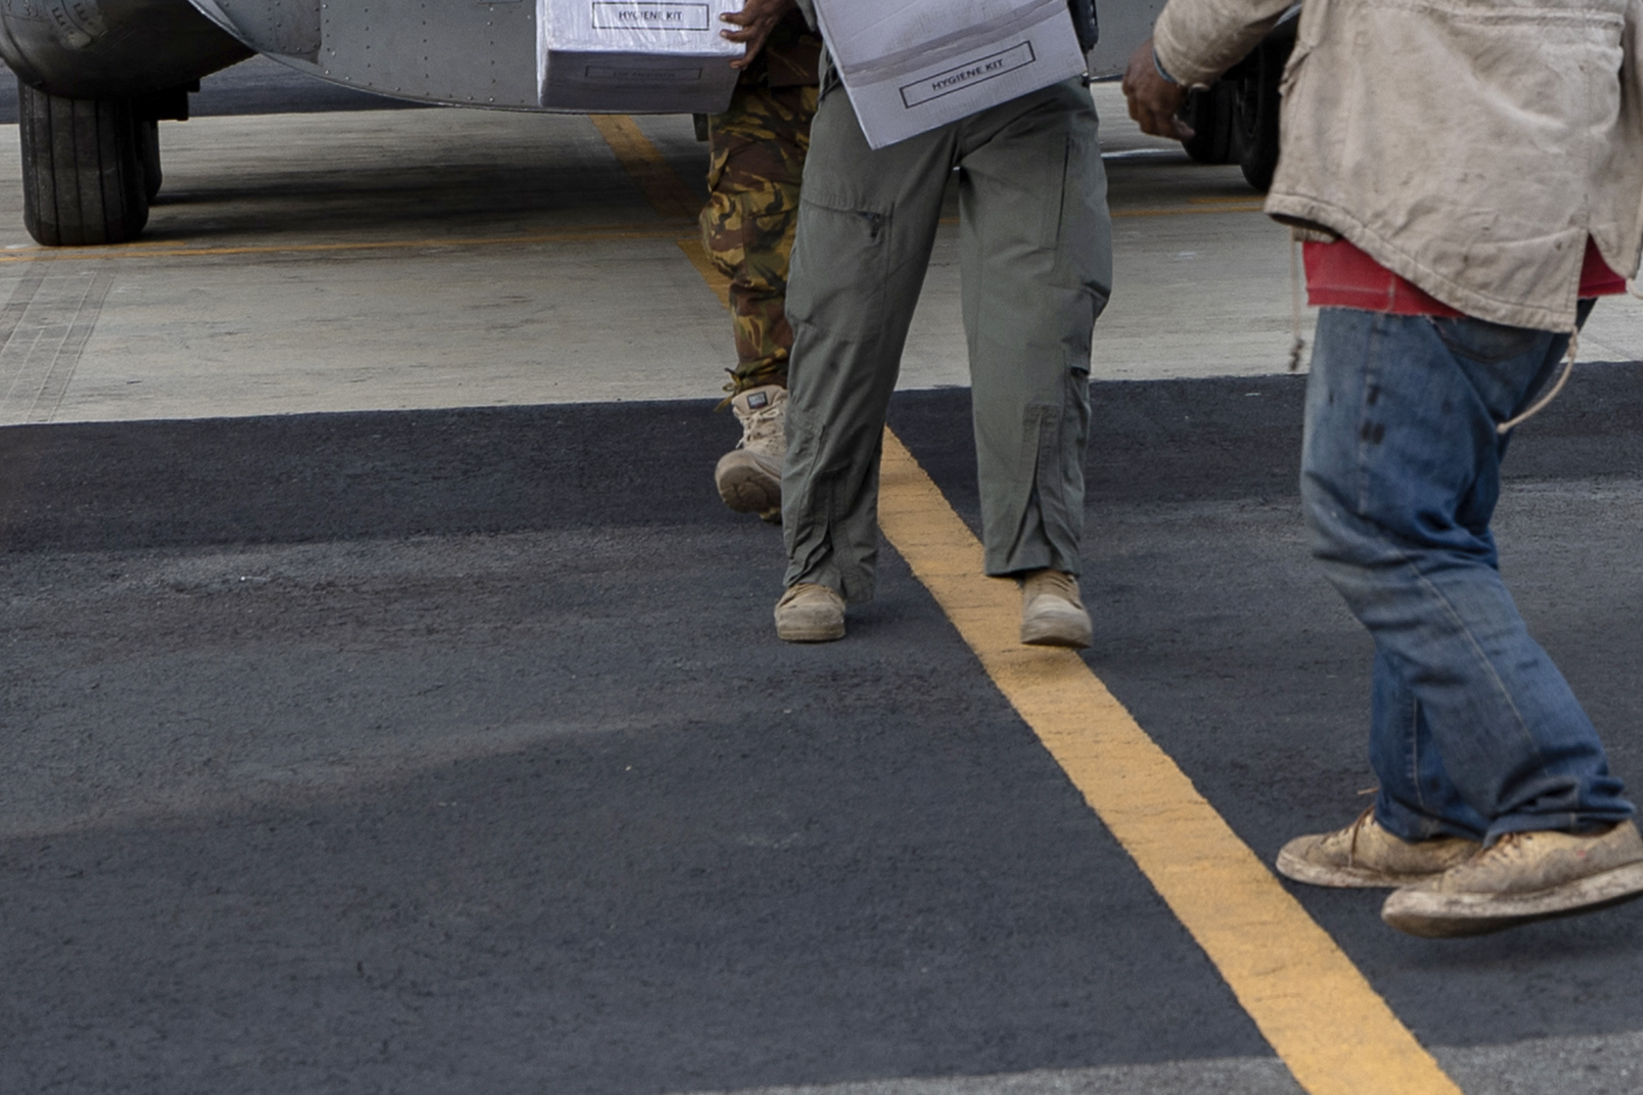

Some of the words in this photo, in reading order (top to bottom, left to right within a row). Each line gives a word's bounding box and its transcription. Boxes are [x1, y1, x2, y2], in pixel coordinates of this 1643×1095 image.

[666, 11, 683, 22] KIT
[931, 66, 984, 92] HYGIENE
[985, 58, 1004, 73] KIT
